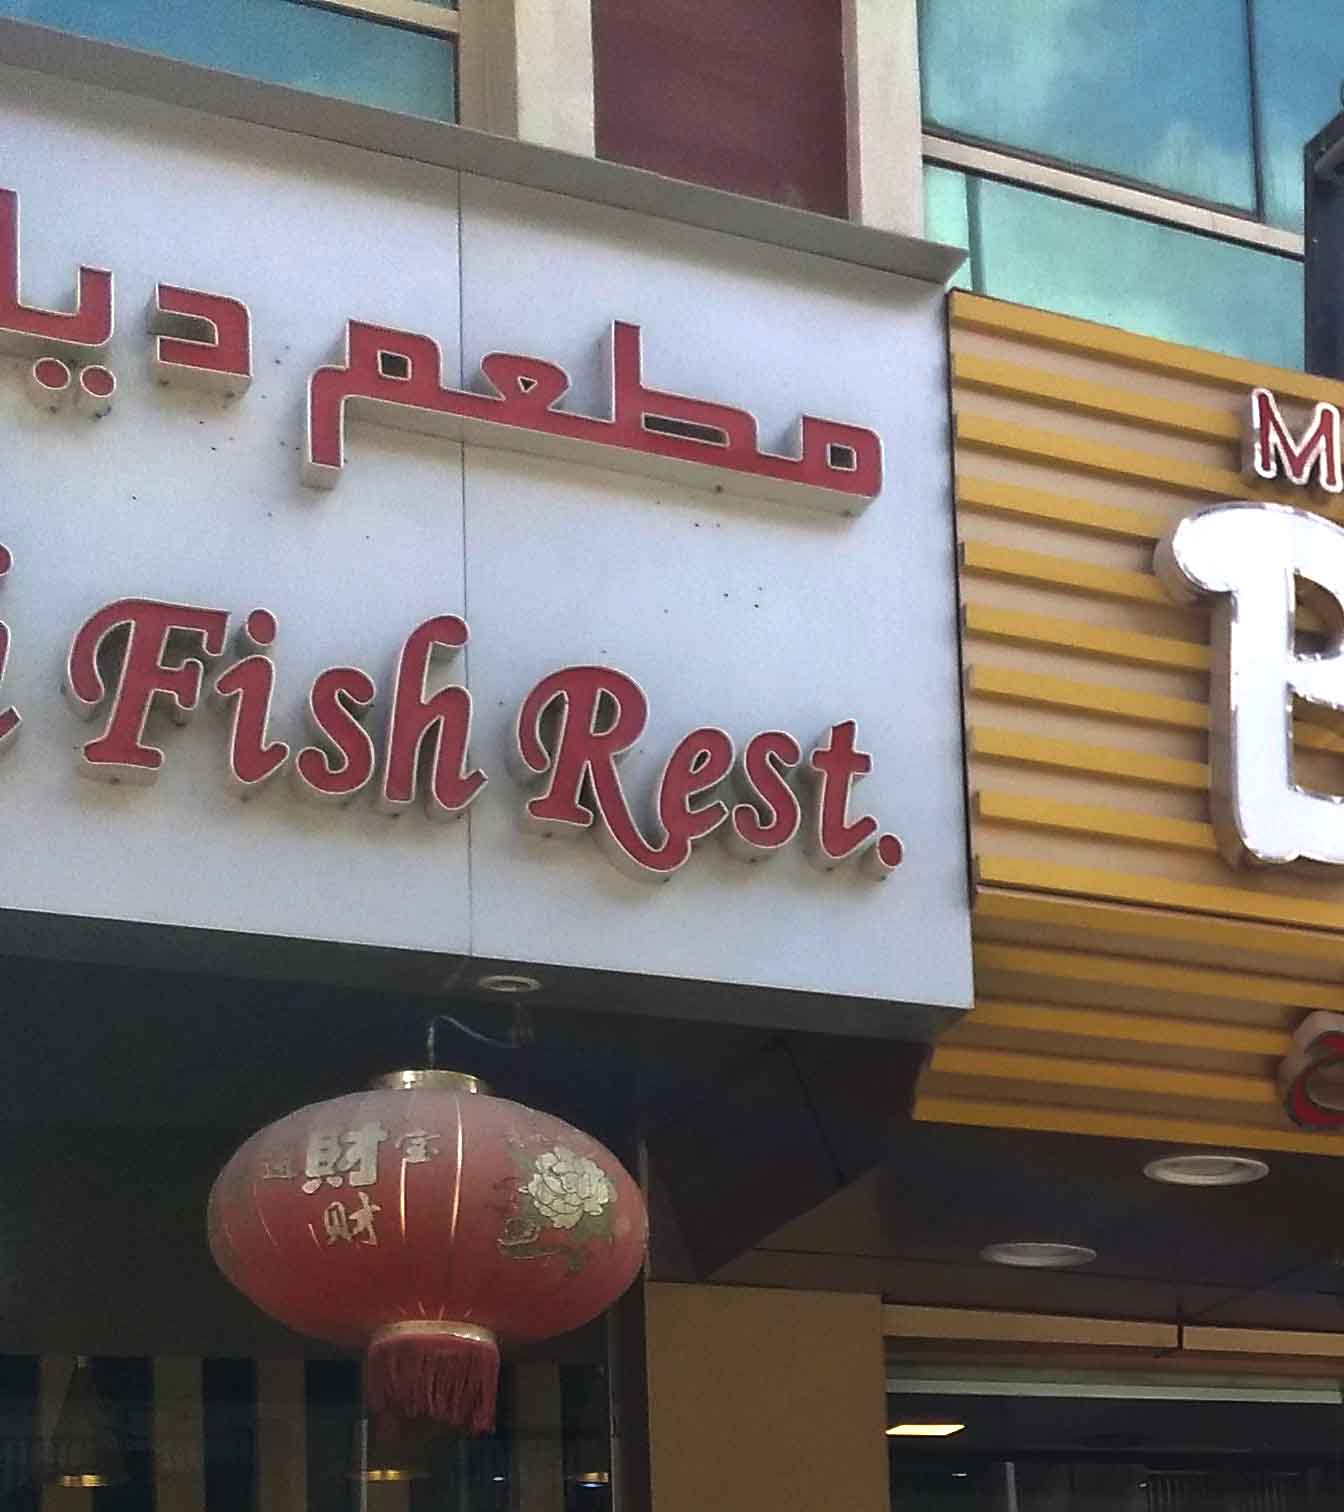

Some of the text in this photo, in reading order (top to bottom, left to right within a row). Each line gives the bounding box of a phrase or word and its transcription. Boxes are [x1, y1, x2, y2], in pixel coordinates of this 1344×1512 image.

[306, 319, 883, 506] مطعم
[66, 597, 489, 812] Fish
[514, 664, 906, 874] Rest.
